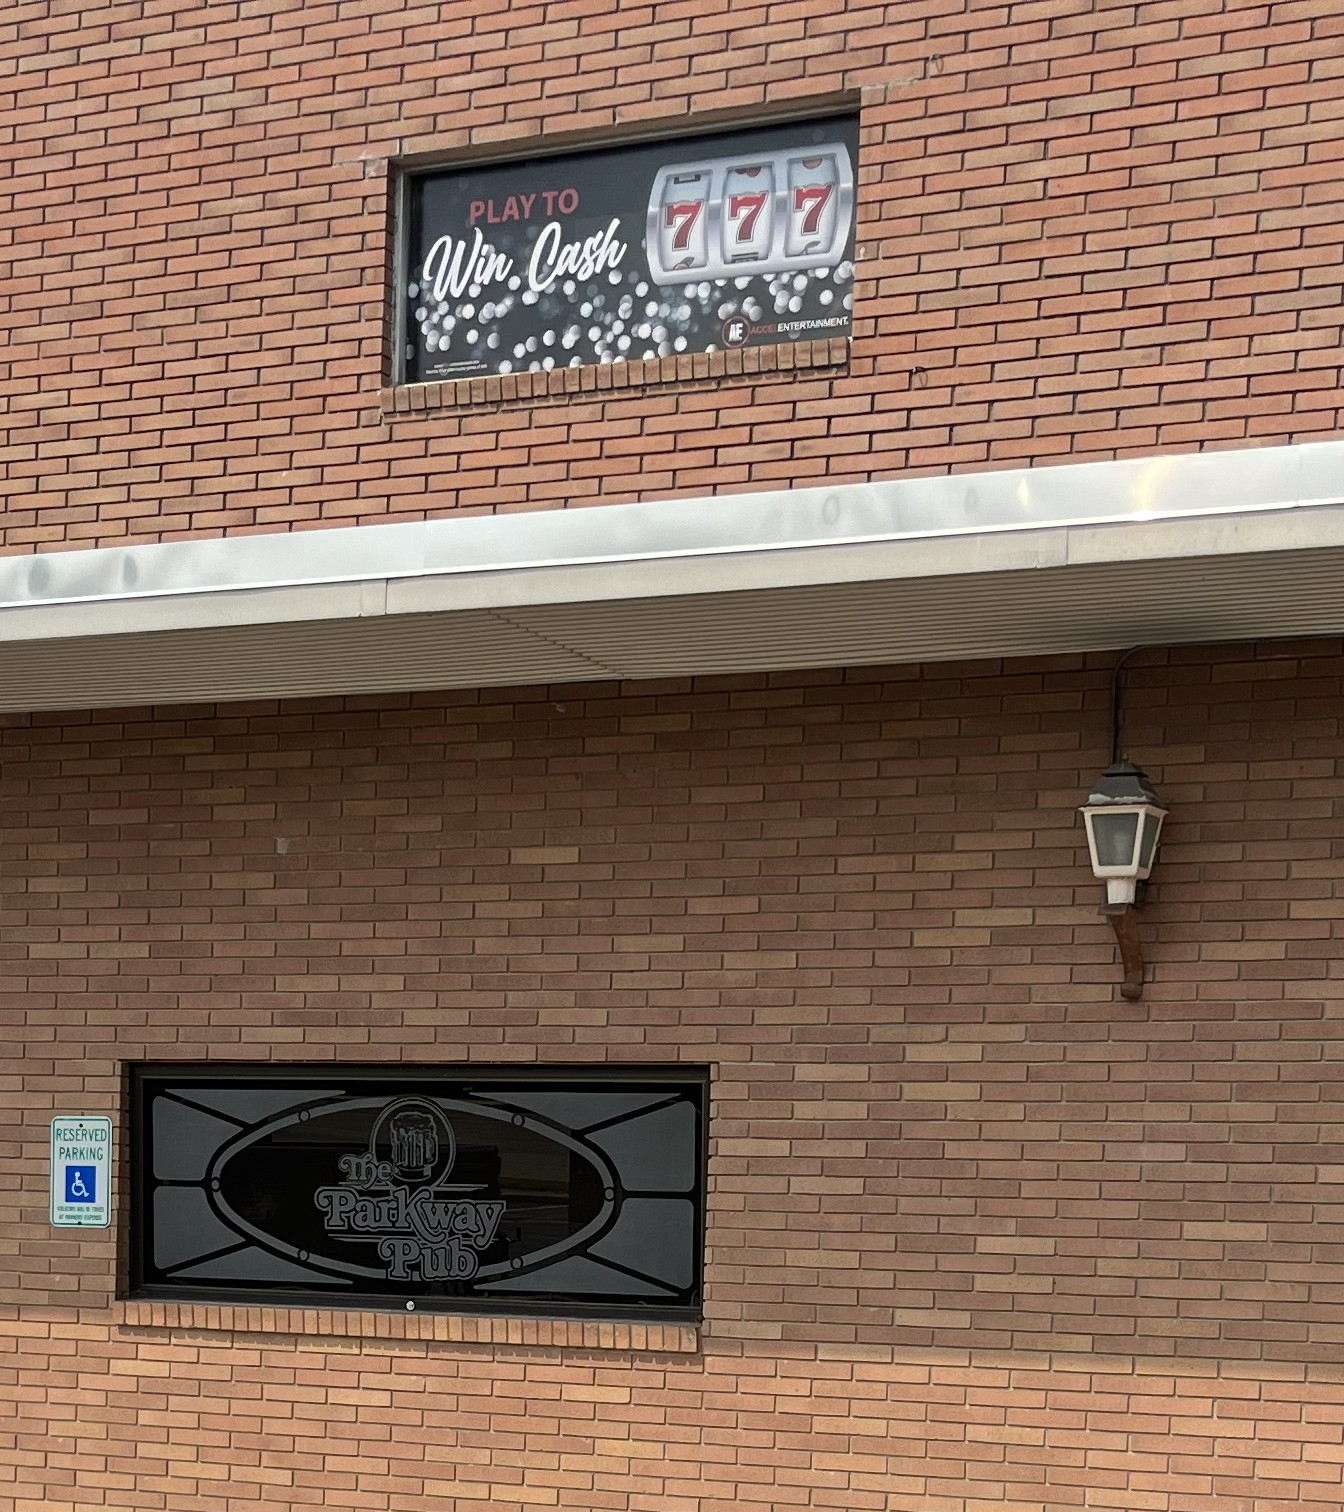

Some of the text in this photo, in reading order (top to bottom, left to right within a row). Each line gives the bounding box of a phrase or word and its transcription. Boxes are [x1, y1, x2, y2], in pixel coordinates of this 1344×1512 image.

[469, 187, 580, 225] PLAY TO
[423, 217, 628, 302] Win Cash
[56, 1128, 107, 1142] RESERVED
[59, 1147, 104, 1161] PARKING
[338, 1151, 394, 1190] The
[378, 1236, 478, 1281] Pub
